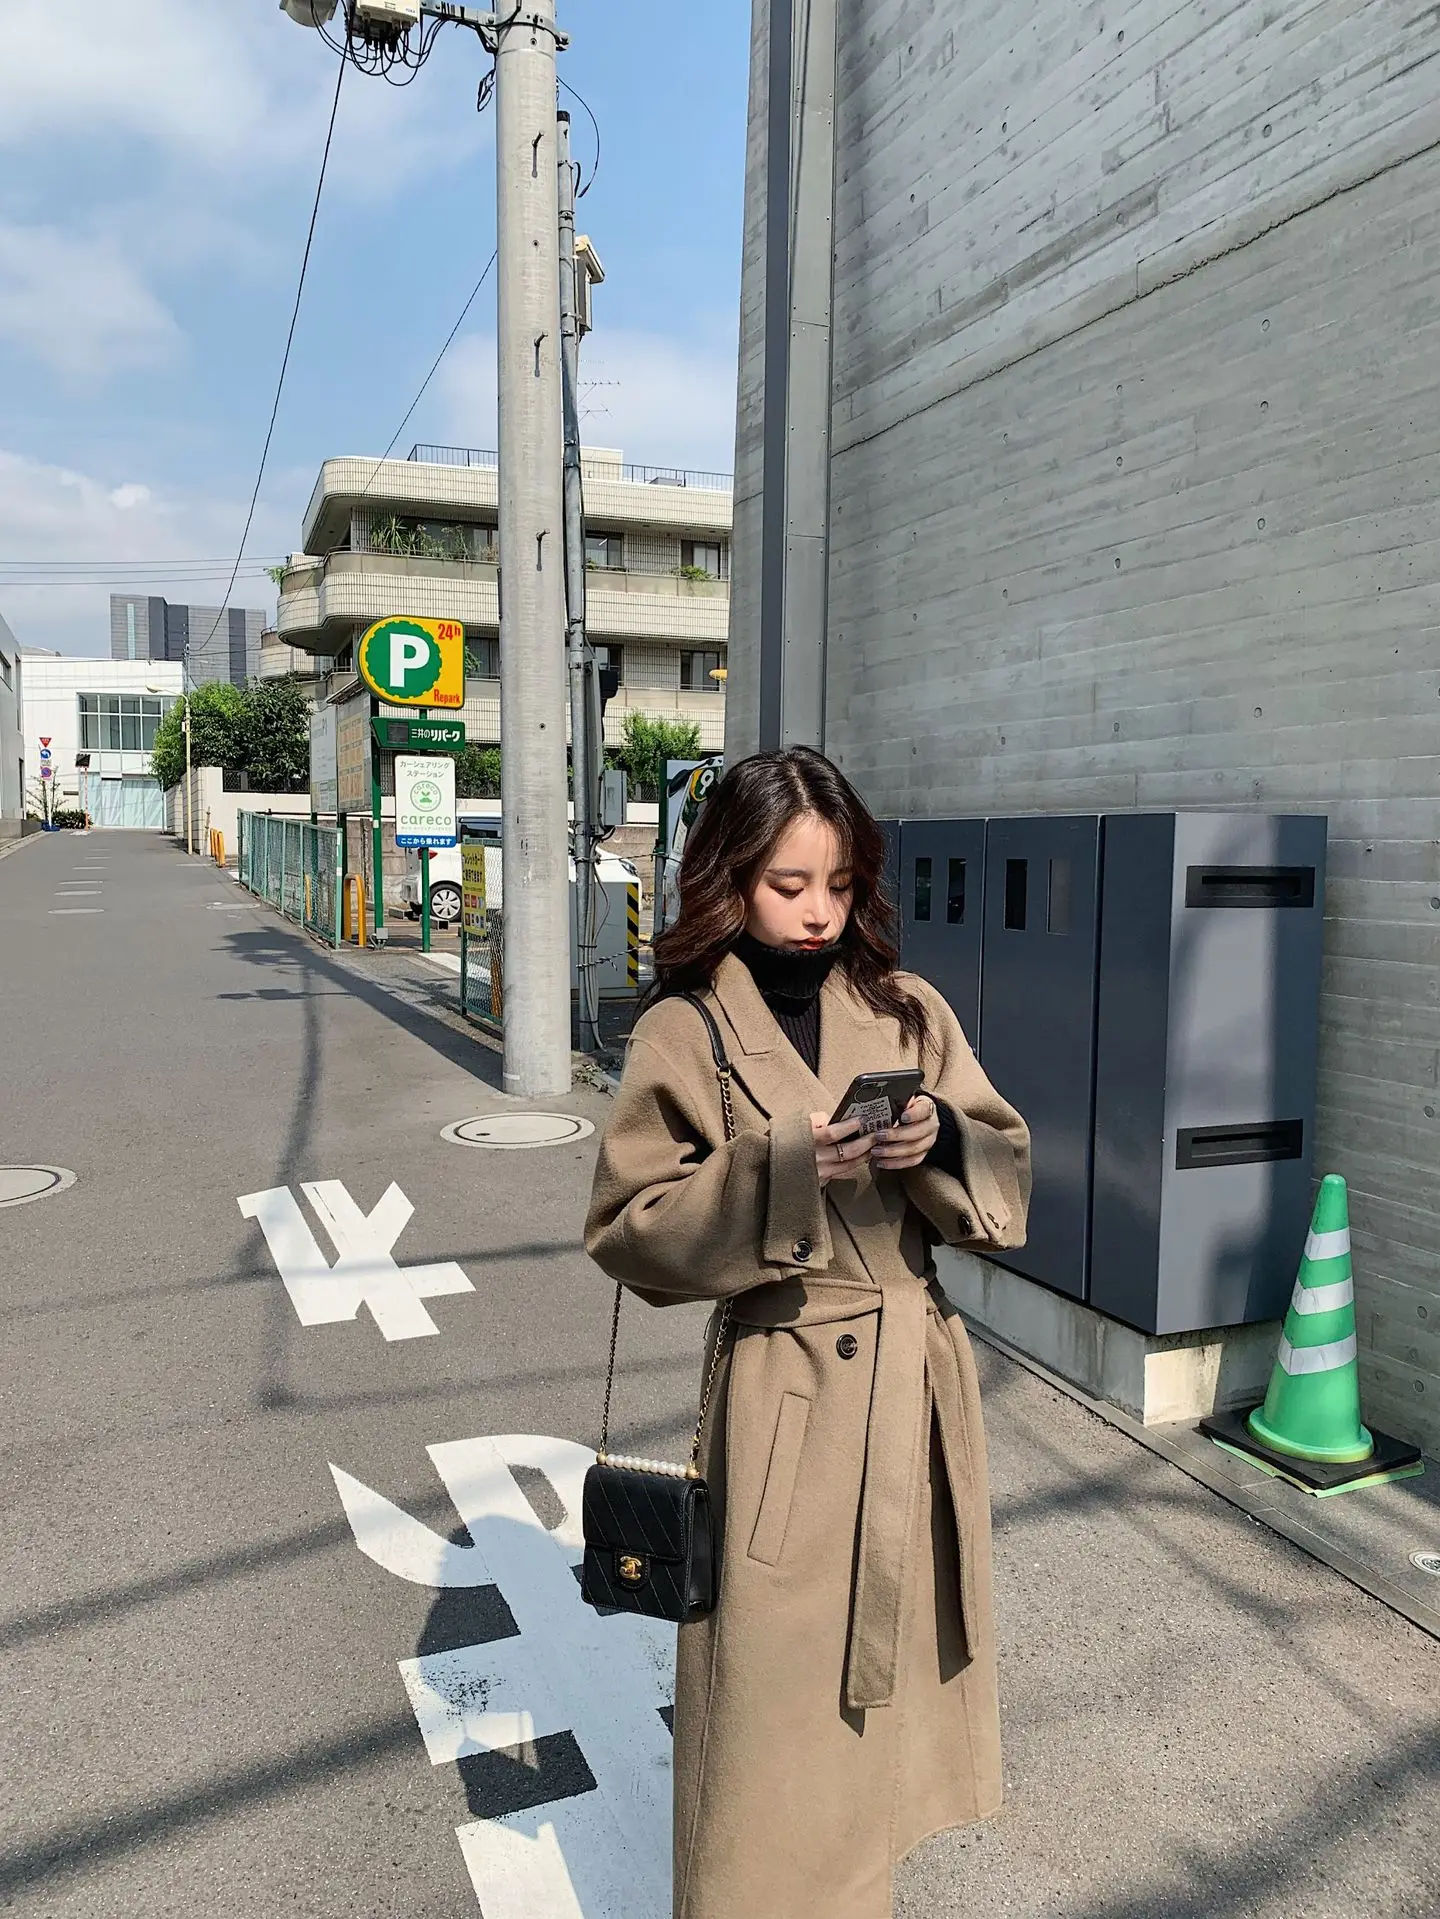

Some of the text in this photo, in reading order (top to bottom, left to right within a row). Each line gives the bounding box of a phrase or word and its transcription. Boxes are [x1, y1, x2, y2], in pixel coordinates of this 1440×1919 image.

[438, 624, 460, 640] 24h
[390, 633, 430, 688] P
[434, 689, 460, 704] Repark
[411, 728, 460, 741] 三井のリパーク
[400, 760, 450, 769] カーシェアリング
[406, 770, 444, 778] ステーション
[414, 783, 438, 796] careco
[400, 814, 452, 826] careco
[400, 838, 452, 846] ここから乗れます
